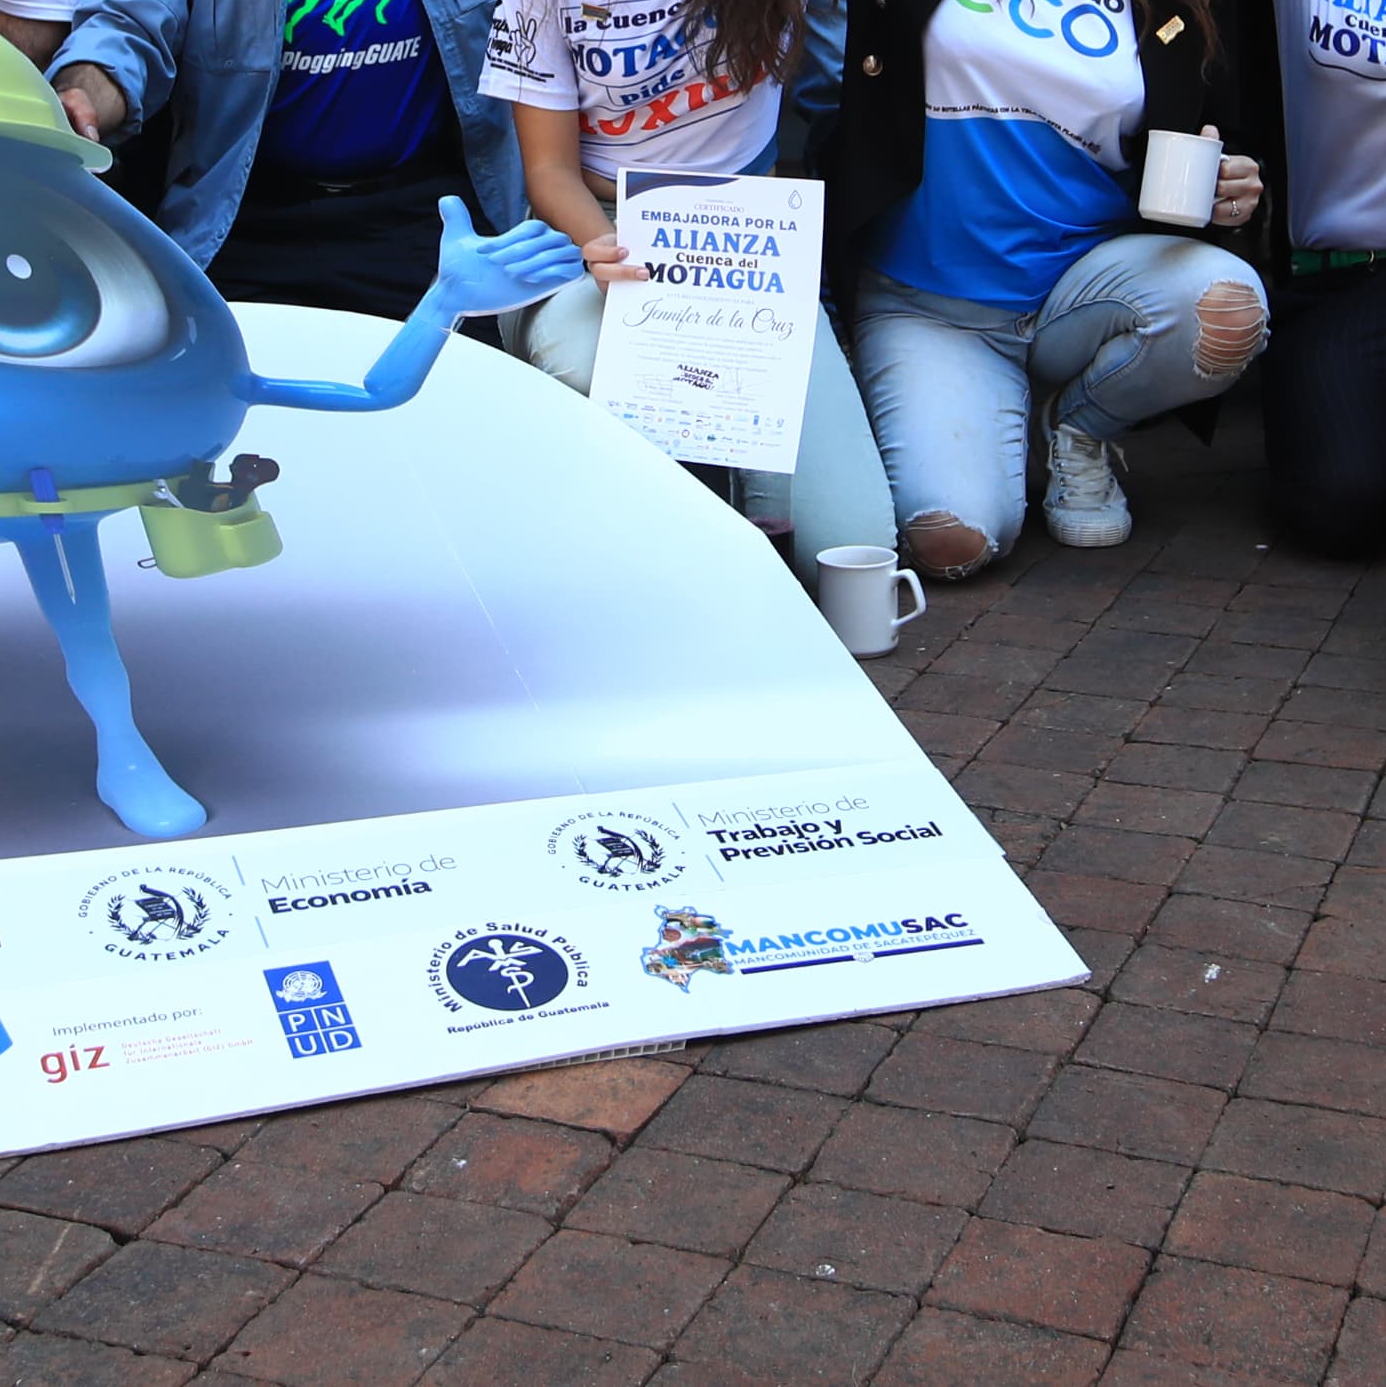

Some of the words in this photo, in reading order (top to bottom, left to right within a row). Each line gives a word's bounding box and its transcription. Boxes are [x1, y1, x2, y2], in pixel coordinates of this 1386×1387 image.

[565, 16, 588, 34] la
[619, 67, 685, 106] pide
[641, 210, 741, 228] EMBAJADORA
[745, 217, 775, 230] POR
[779, 220, 798, 231] LA
[651, 227, 781, 257] ALIANZA
[645, 262, 785, 294] MOTAGUA
[676, 252, 733, 267] Cuenca
[738, 257, 758, 269] del
[751, 307, 796, 341] Cruz
[697, 799, 830, 829] Ministerio
[835, 795, 870, 812] de
[547, 818, 577, 855] GOBIERNO
[579, 812, 596, 822] DE
[706, 819, 820, 845] Trabajo
[822, 817, 844, 836] y
[719, 833, 855, 863] Previsión
[856, 820, 944, 846] Social
[260, 861, 412, 894] Ministerio
[419, 853, 458, 873] de
[579, 864, 687, 893] GUATEMALA
[78, 873, 117, 919] GOBIERNO
[121, 867, 140, 879] DE
[144, 865, 163, 874] LA
[266, 876, 433, 915] Economía
[103, 927, 231, 962] GUATEMALA
[724, 912, 970, 958] MANCOMUSAC
[733, 943, 851, 967] MANCOMUNIDAD
[853, 941, 871, 951] DE
[873, 927, 976, 950] SACATEPÉQUEZ
[426, 941, 463, 1014] Ministerio
[454, 927, 479, 942] de
[485, 921, 549, 939] Salud
[551, 935, 591, 989] Pública
[52, 1012, 168, 1038] Implementado
[171, 1007, 204, 1023] por:
[447, 1016, 515, 1035] República
[517, 1013, 535, 1023] de
[536, 1000, 611, 1019] Guatemala
[40, 1043, 111, 1085] giz
